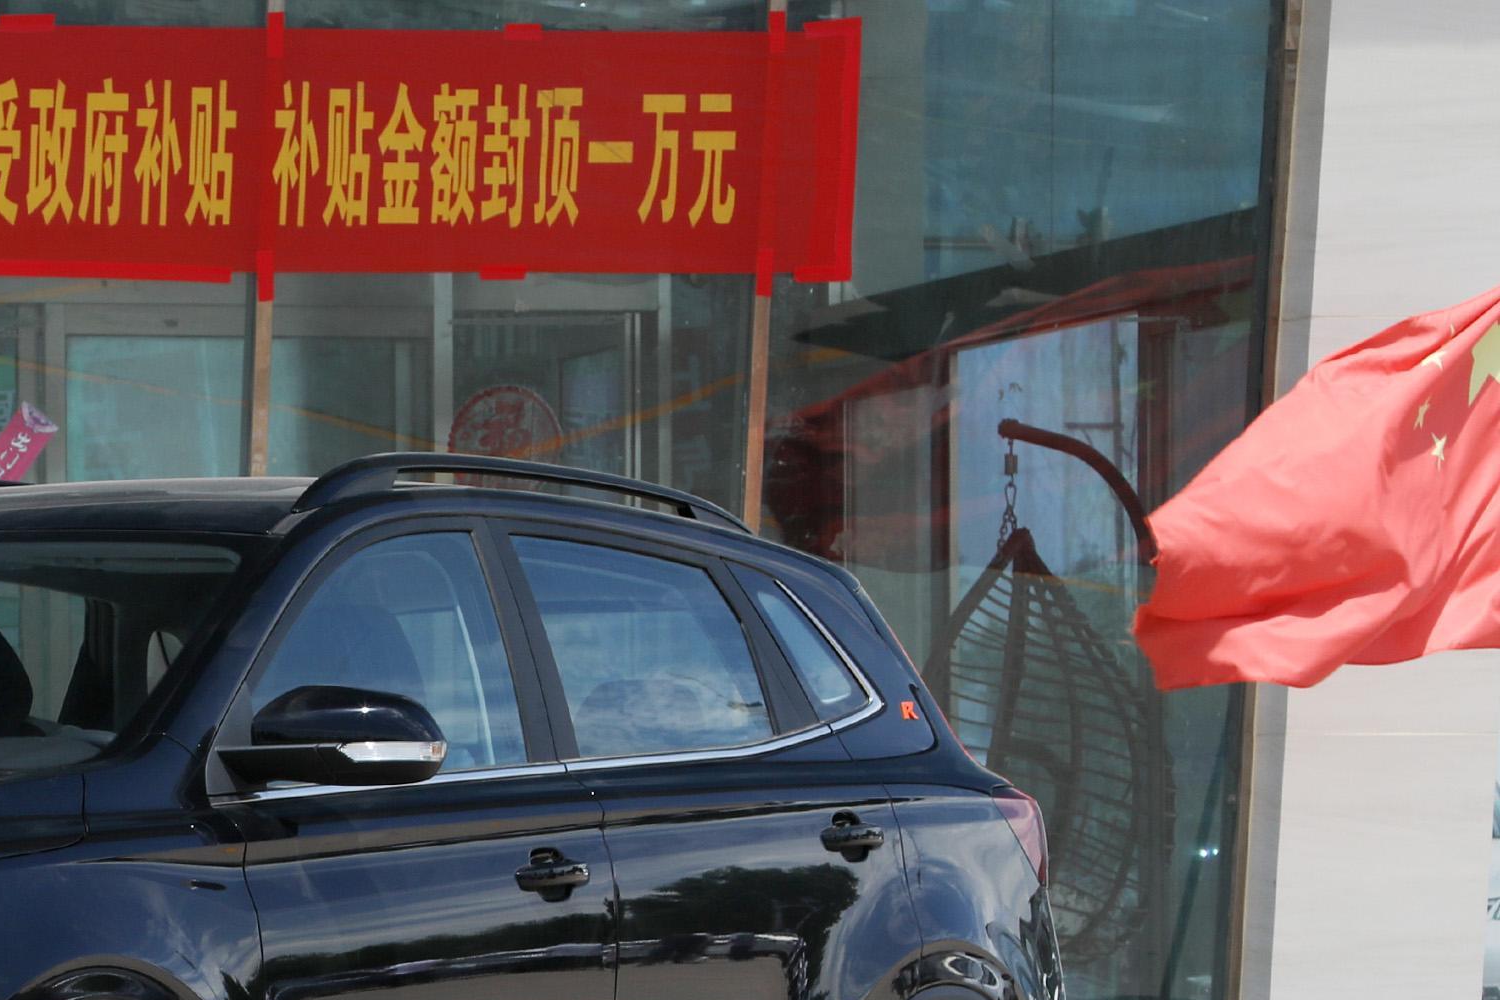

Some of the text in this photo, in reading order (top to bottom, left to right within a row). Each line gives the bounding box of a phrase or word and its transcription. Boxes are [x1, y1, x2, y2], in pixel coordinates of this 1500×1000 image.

[273, 80, 736, 228] 补贴金额封顶一万元
